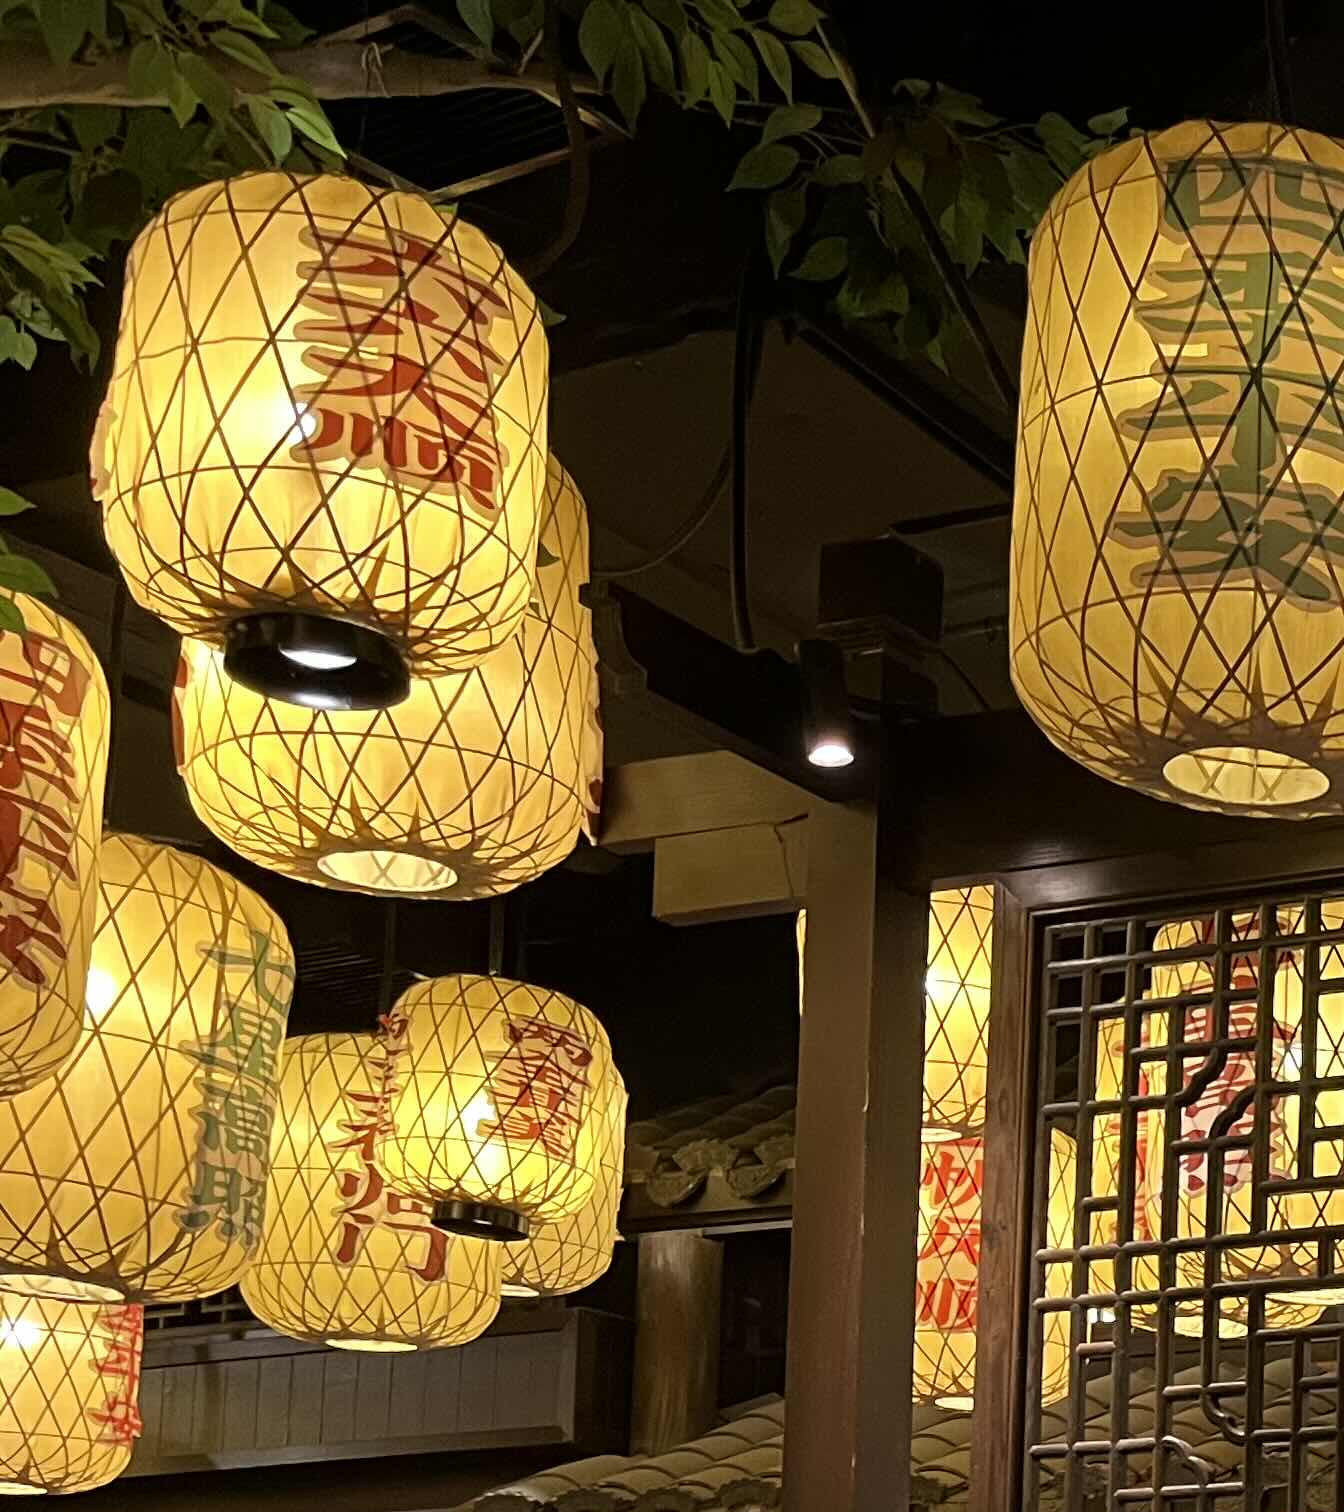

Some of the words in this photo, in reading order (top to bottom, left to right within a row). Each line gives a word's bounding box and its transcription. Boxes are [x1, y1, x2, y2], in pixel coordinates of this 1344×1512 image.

[298, 230, 512, 513] 六六大顺
[178, 928, 296, 1266] 七星高照
